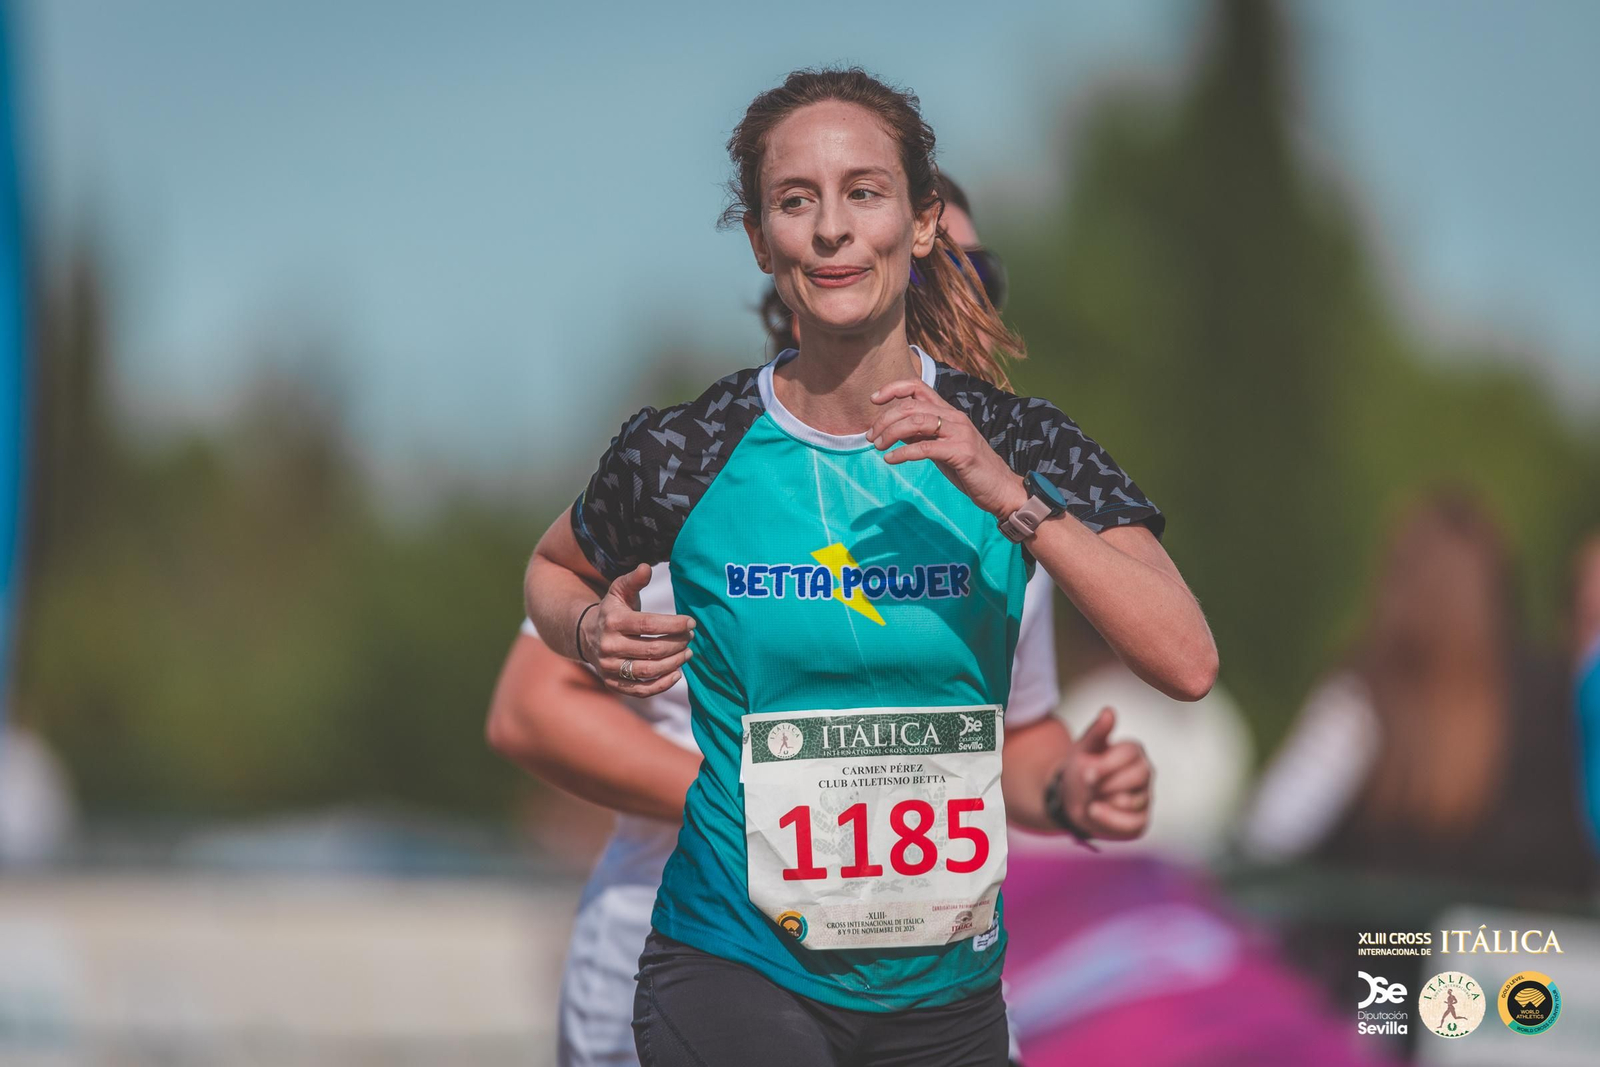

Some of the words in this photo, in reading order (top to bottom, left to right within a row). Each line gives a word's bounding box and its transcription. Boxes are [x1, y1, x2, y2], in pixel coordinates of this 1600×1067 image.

[725, 563, 833, 600] BETTA
[841, 562, 970, 600] POWER
[821, 718, 942, 749] ITÁLICA
[823, 748, 880, 756] INTERNATIONAL
[958, 742, 983, 750] Sevilla
[842, 765, 887, 775] CARMEN
[890, 763, 923, 773] PÉREZ
[818, 779, 848, 788] CLUB
[850, 777, 910, 787] ATLETISMO
[912, 775, 946, 784] BETTA
[779, 798, 990, 880] 1185
[826, 921, 846, 929] CROSS
[847, 919, 893, 928] INTERNACIONAL
[861, 926, 894, 934] NOVIEMBRE
